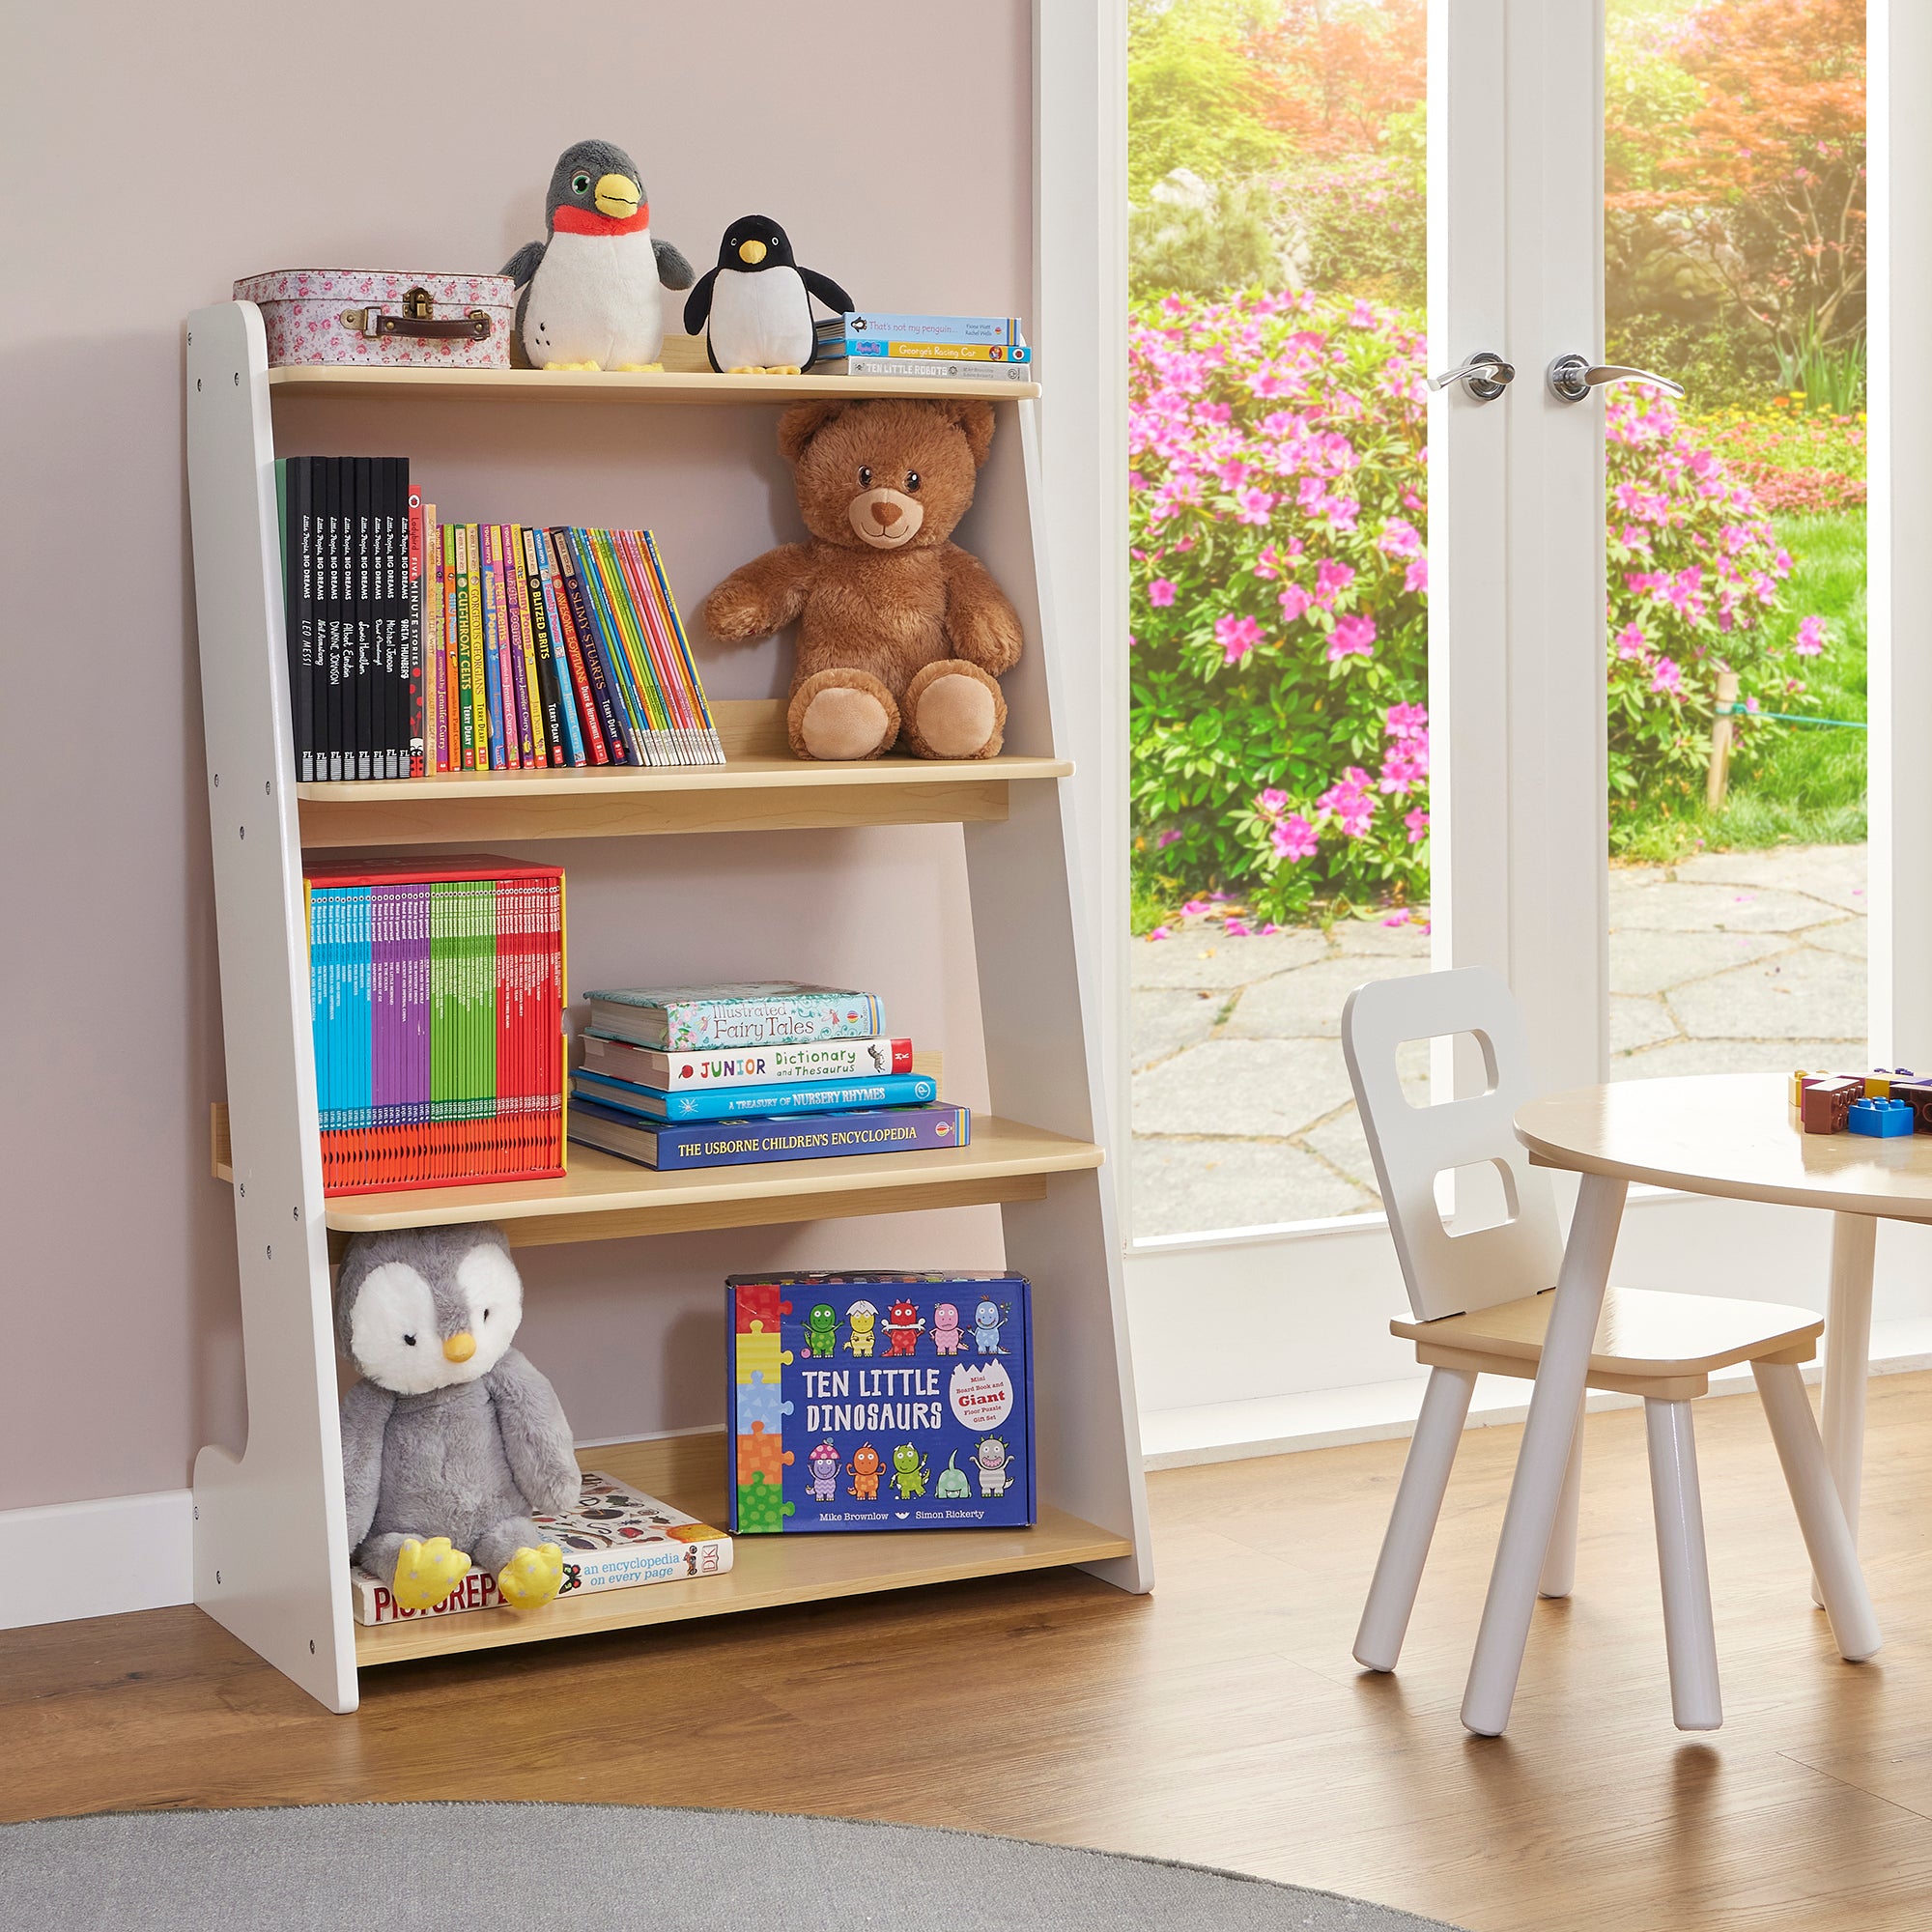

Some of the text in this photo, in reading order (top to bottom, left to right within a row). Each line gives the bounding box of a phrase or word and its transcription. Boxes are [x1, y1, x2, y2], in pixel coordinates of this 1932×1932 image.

[868, 321, 894, 330] That's
[908, 326, 920, 334] my
[899, 345, 975, 357] George's Racing Car
[867, 363, 948, 375] TEN LITTLE ROBOTS
[410, 518, 419, 550] Ladybird
[507, 570, 518, 605] Magic
[411, 581, 419, 625] MINUTE
[470, 589, 482, 643] GORGEOUS
[496, 582, 507, 640] Pet Poems
[519, 581, 533, 650] Funny Poems
[545, 583, 555, 612] Family
[552, 614, 562, 643] Poems
[386, 620, 396, 647] Michael
[459, 591, 470, 656] CUT-THROAT
[488, 613, 497, 650] Poems
[511, 608, 522, 645] Poems
[302, 620, 311, 667] LEO MESSI
[329, 621, 340, 685] DWAYNE JOHNSON
[343, 623, 354, 678] Albert Einstein
[358, 643, 369, 675] Hamilton
[473, 645, 484, 695] GEORGIANS
[532, 591, 559, 743] BLITZED BRITS TERRY DEARY
[555, 592, 574, 635] AWESOME
[567, 637, 586, 683] EGYPTIANS
[581, 686, 590, 701] DEARY
[586, 708, 600, 739] HEPPLEWHITE
[571, 592, 618, 738] SLIMY STUARTS TERRY DEARY
[461, 660, 471, 690] CELTS
[439, 691, 448, 723] Jennifer
[502, 684, 512, 712] Jennifer
[519, 684, 527, 710] Jennifer
[564, 693, 578, 724] Jennifer
[464, 705, 472, 725] TERRY
[533, 715, 542, 735] Dean
[438, 725, 447, 750] Curry
[713, 1003, 787, 1019] Illustrated
[714, 1017, 813, 1041] Fairy Tales
[700, 1058, 765, 1079] JUNIOR
[776, 1049, 856, 1065] Dictionary
[777, 1065, 855, 1077] and Thesaurus
[728, 1088, 886, 1111] A TREASURY OF NURSERY RHYMES
[678, 1126, 917, 1157] THE USBORNE CHILDREN'S ENCYCLOPEDIA
[802, 1368, 941, 1398] TEN LITTLE
[958, 1390, 1006, 1408] Giant
[806, 1402, 942, 1432] DINOSAURS
[819, 1512, 889, 1521] Mike Brownlow
[916, 1510, 984, 1520] Simon Rickerty
[583, 1554, 679, 1576] an encyclopedia
[703, 1547, 717, 1572] DK
[590, 1567, 673, 1586] on every page
